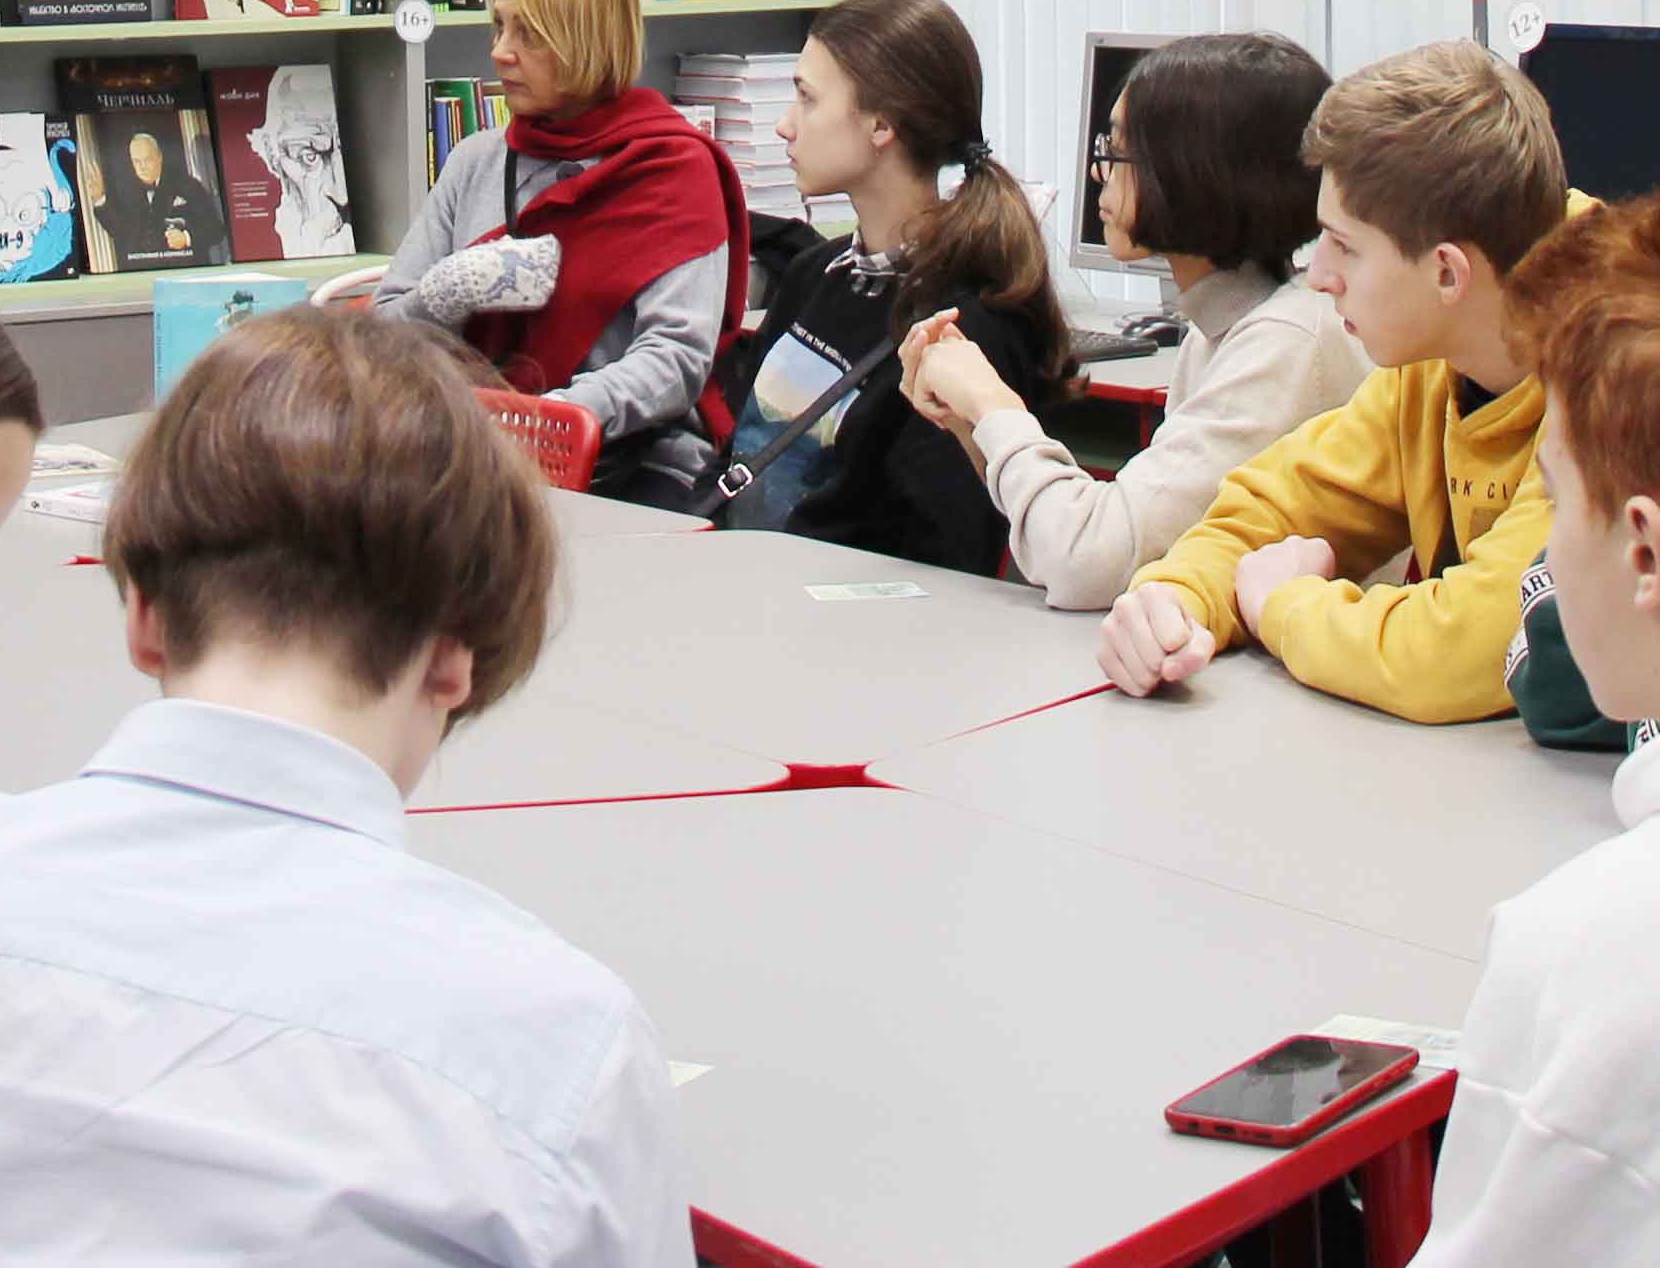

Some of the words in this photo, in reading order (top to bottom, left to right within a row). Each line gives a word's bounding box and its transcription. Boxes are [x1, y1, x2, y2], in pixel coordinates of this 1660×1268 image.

[401, 11, 429, 26] 16+
[1509, 12, 1542, 38] 12+
[97, 92, 174, 108] ЧЕРЧИЛЛЬ
